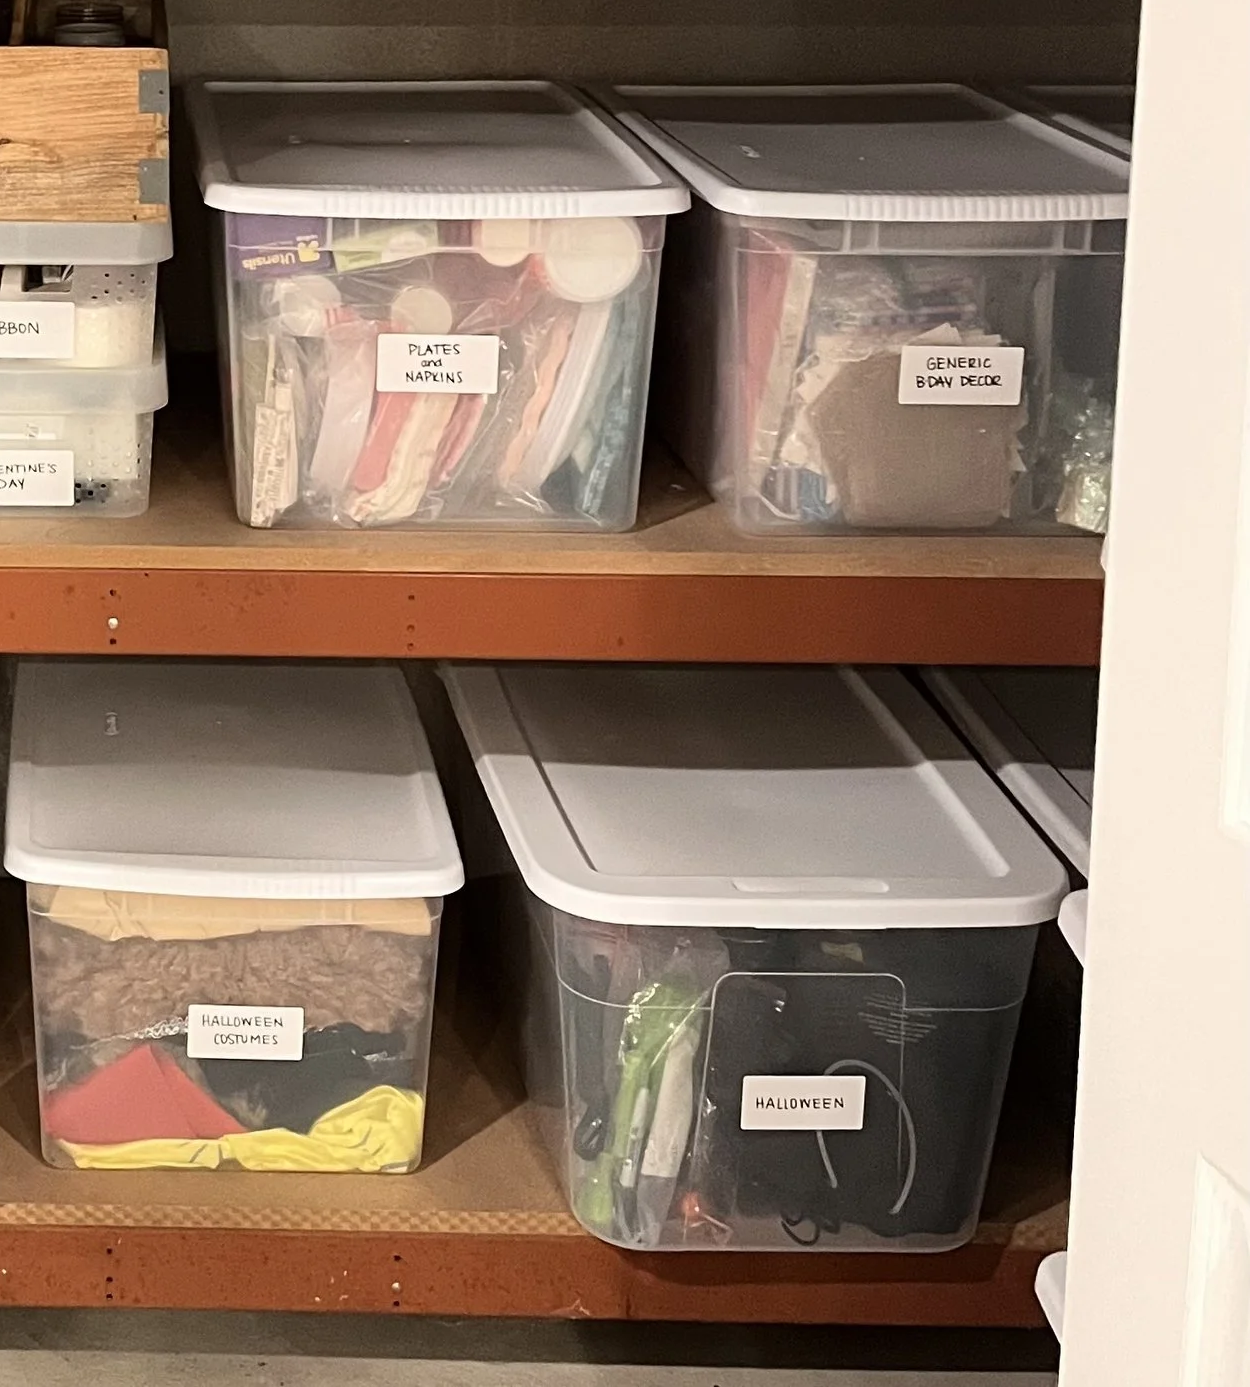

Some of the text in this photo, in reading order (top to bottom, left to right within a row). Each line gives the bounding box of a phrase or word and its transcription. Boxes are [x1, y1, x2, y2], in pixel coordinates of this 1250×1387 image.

[408, 344, 460, 356] PLATES
[421, 358, 443, 368] and
[927, 357, 992, 369] GENERIC
[405, 371, 463, 384] NAPKINS
[960, 376, 1002, 387] DECOR
[202, 1016, 283, 1028] HALLOWEEN
[214, 1034, 278, 1045] COSTUMES
[755, 1097, 844, 1110] HALLOWEEN
